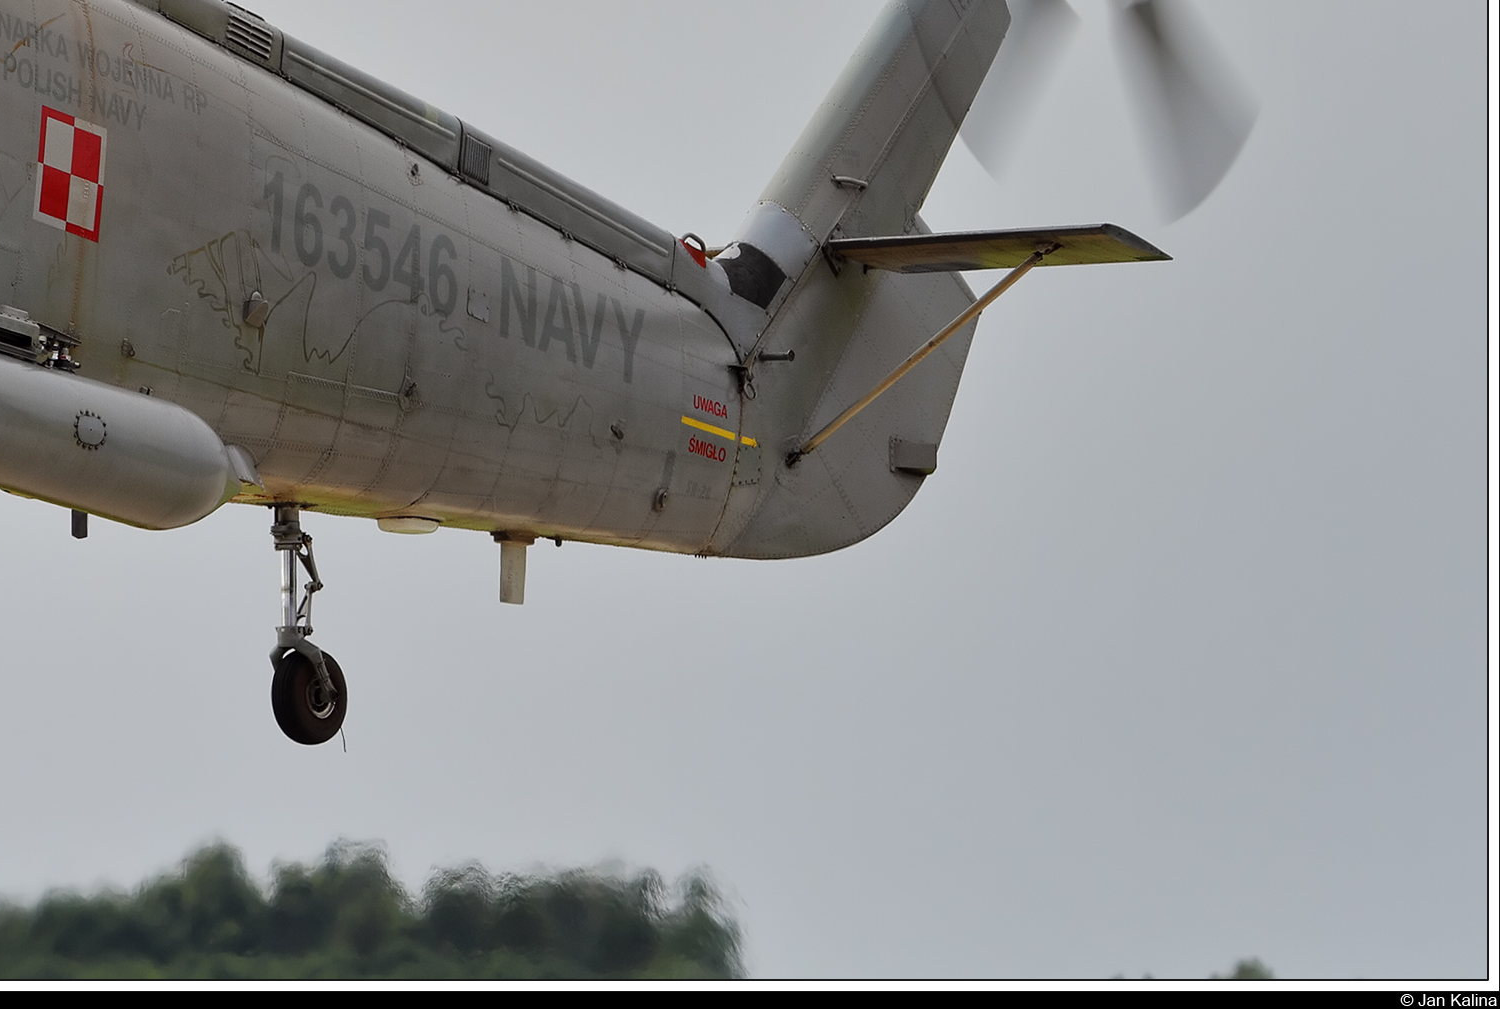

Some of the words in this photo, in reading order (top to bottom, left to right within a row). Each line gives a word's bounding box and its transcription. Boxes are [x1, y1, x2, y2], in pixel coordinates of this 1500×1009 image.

[4, 53, 82, 106] POLISH
[92, 88, 148, 131] NAVY
[77, 43, 175, 104] WOJENNA
[184, 84, 208, 115] RP
[263, 171, 459, 318] 163546
[501, 257, 645, 384] NAVY
[693, 394, 728, 419] UWAGA
[688, 434, 726, 462] ŚMIGŁO
